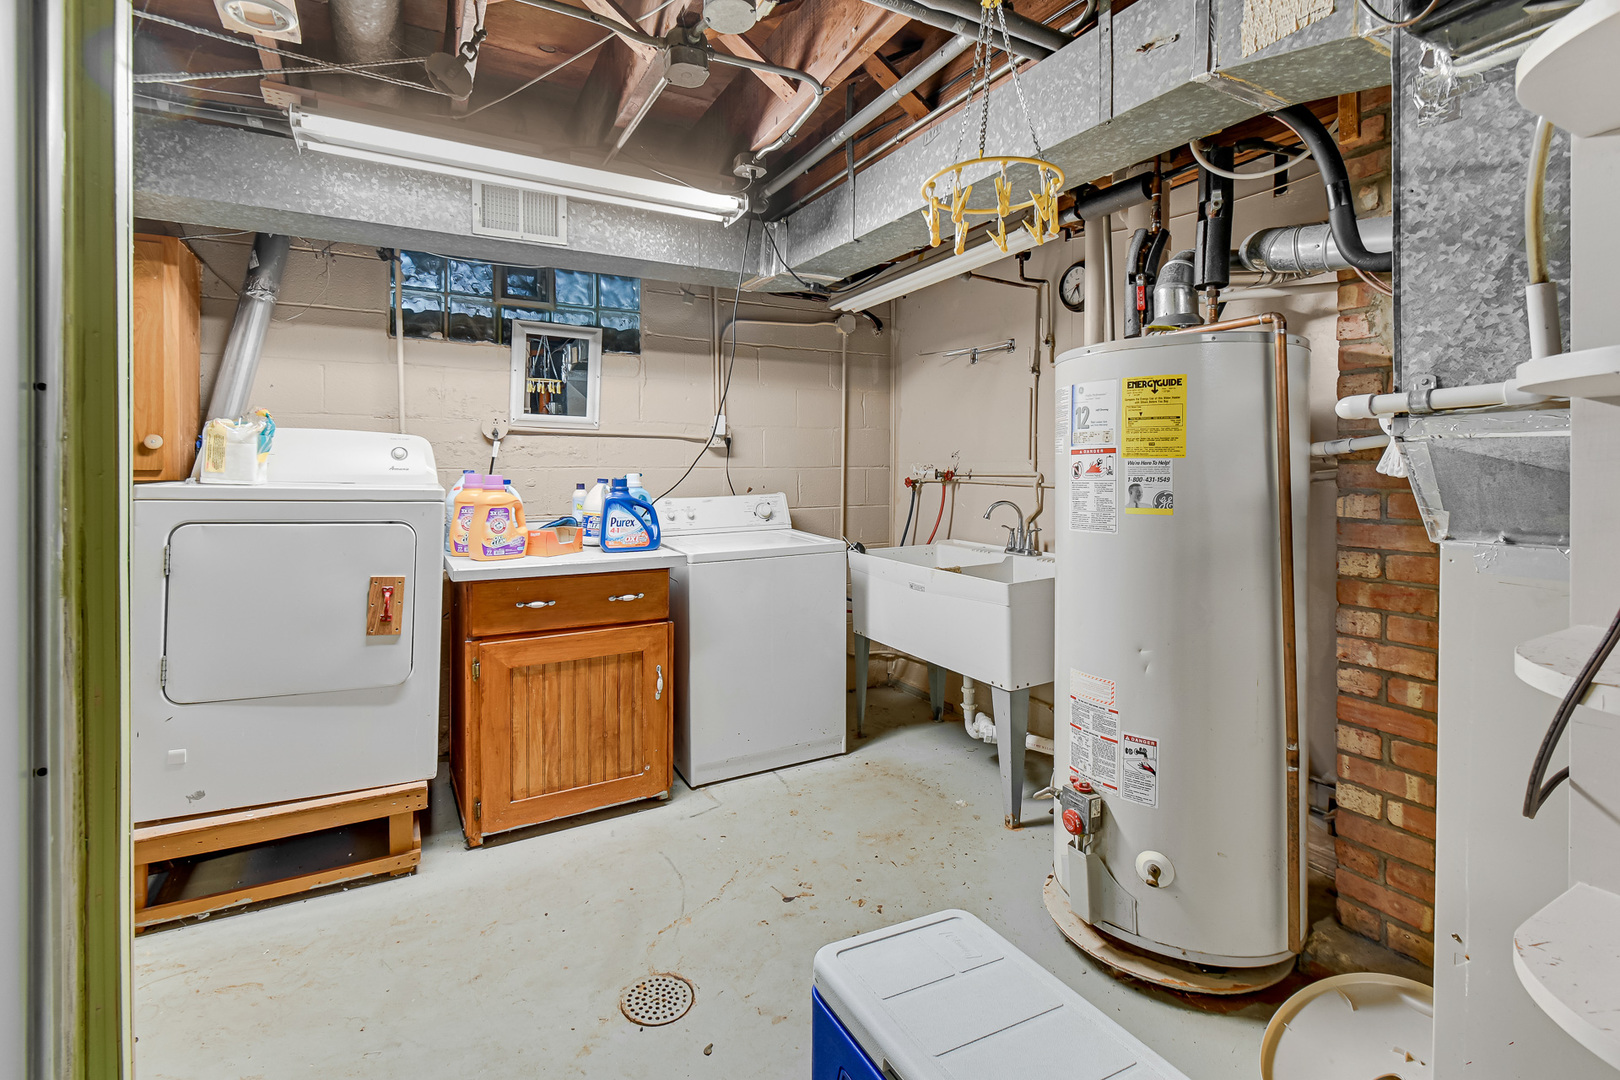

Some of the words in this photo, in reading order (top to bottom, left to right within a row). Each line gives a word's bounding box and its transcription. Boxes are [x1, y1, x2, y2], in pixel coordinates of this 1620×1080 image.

[918, 8, 927, 17] ID
[1127, 378, 1182, 391] ENERGYGUIDE
[1075, 406, 1090, 429] 12
[610, 517, 635, 527] Purex
[1131, 737, 1155, 746] DANGER
